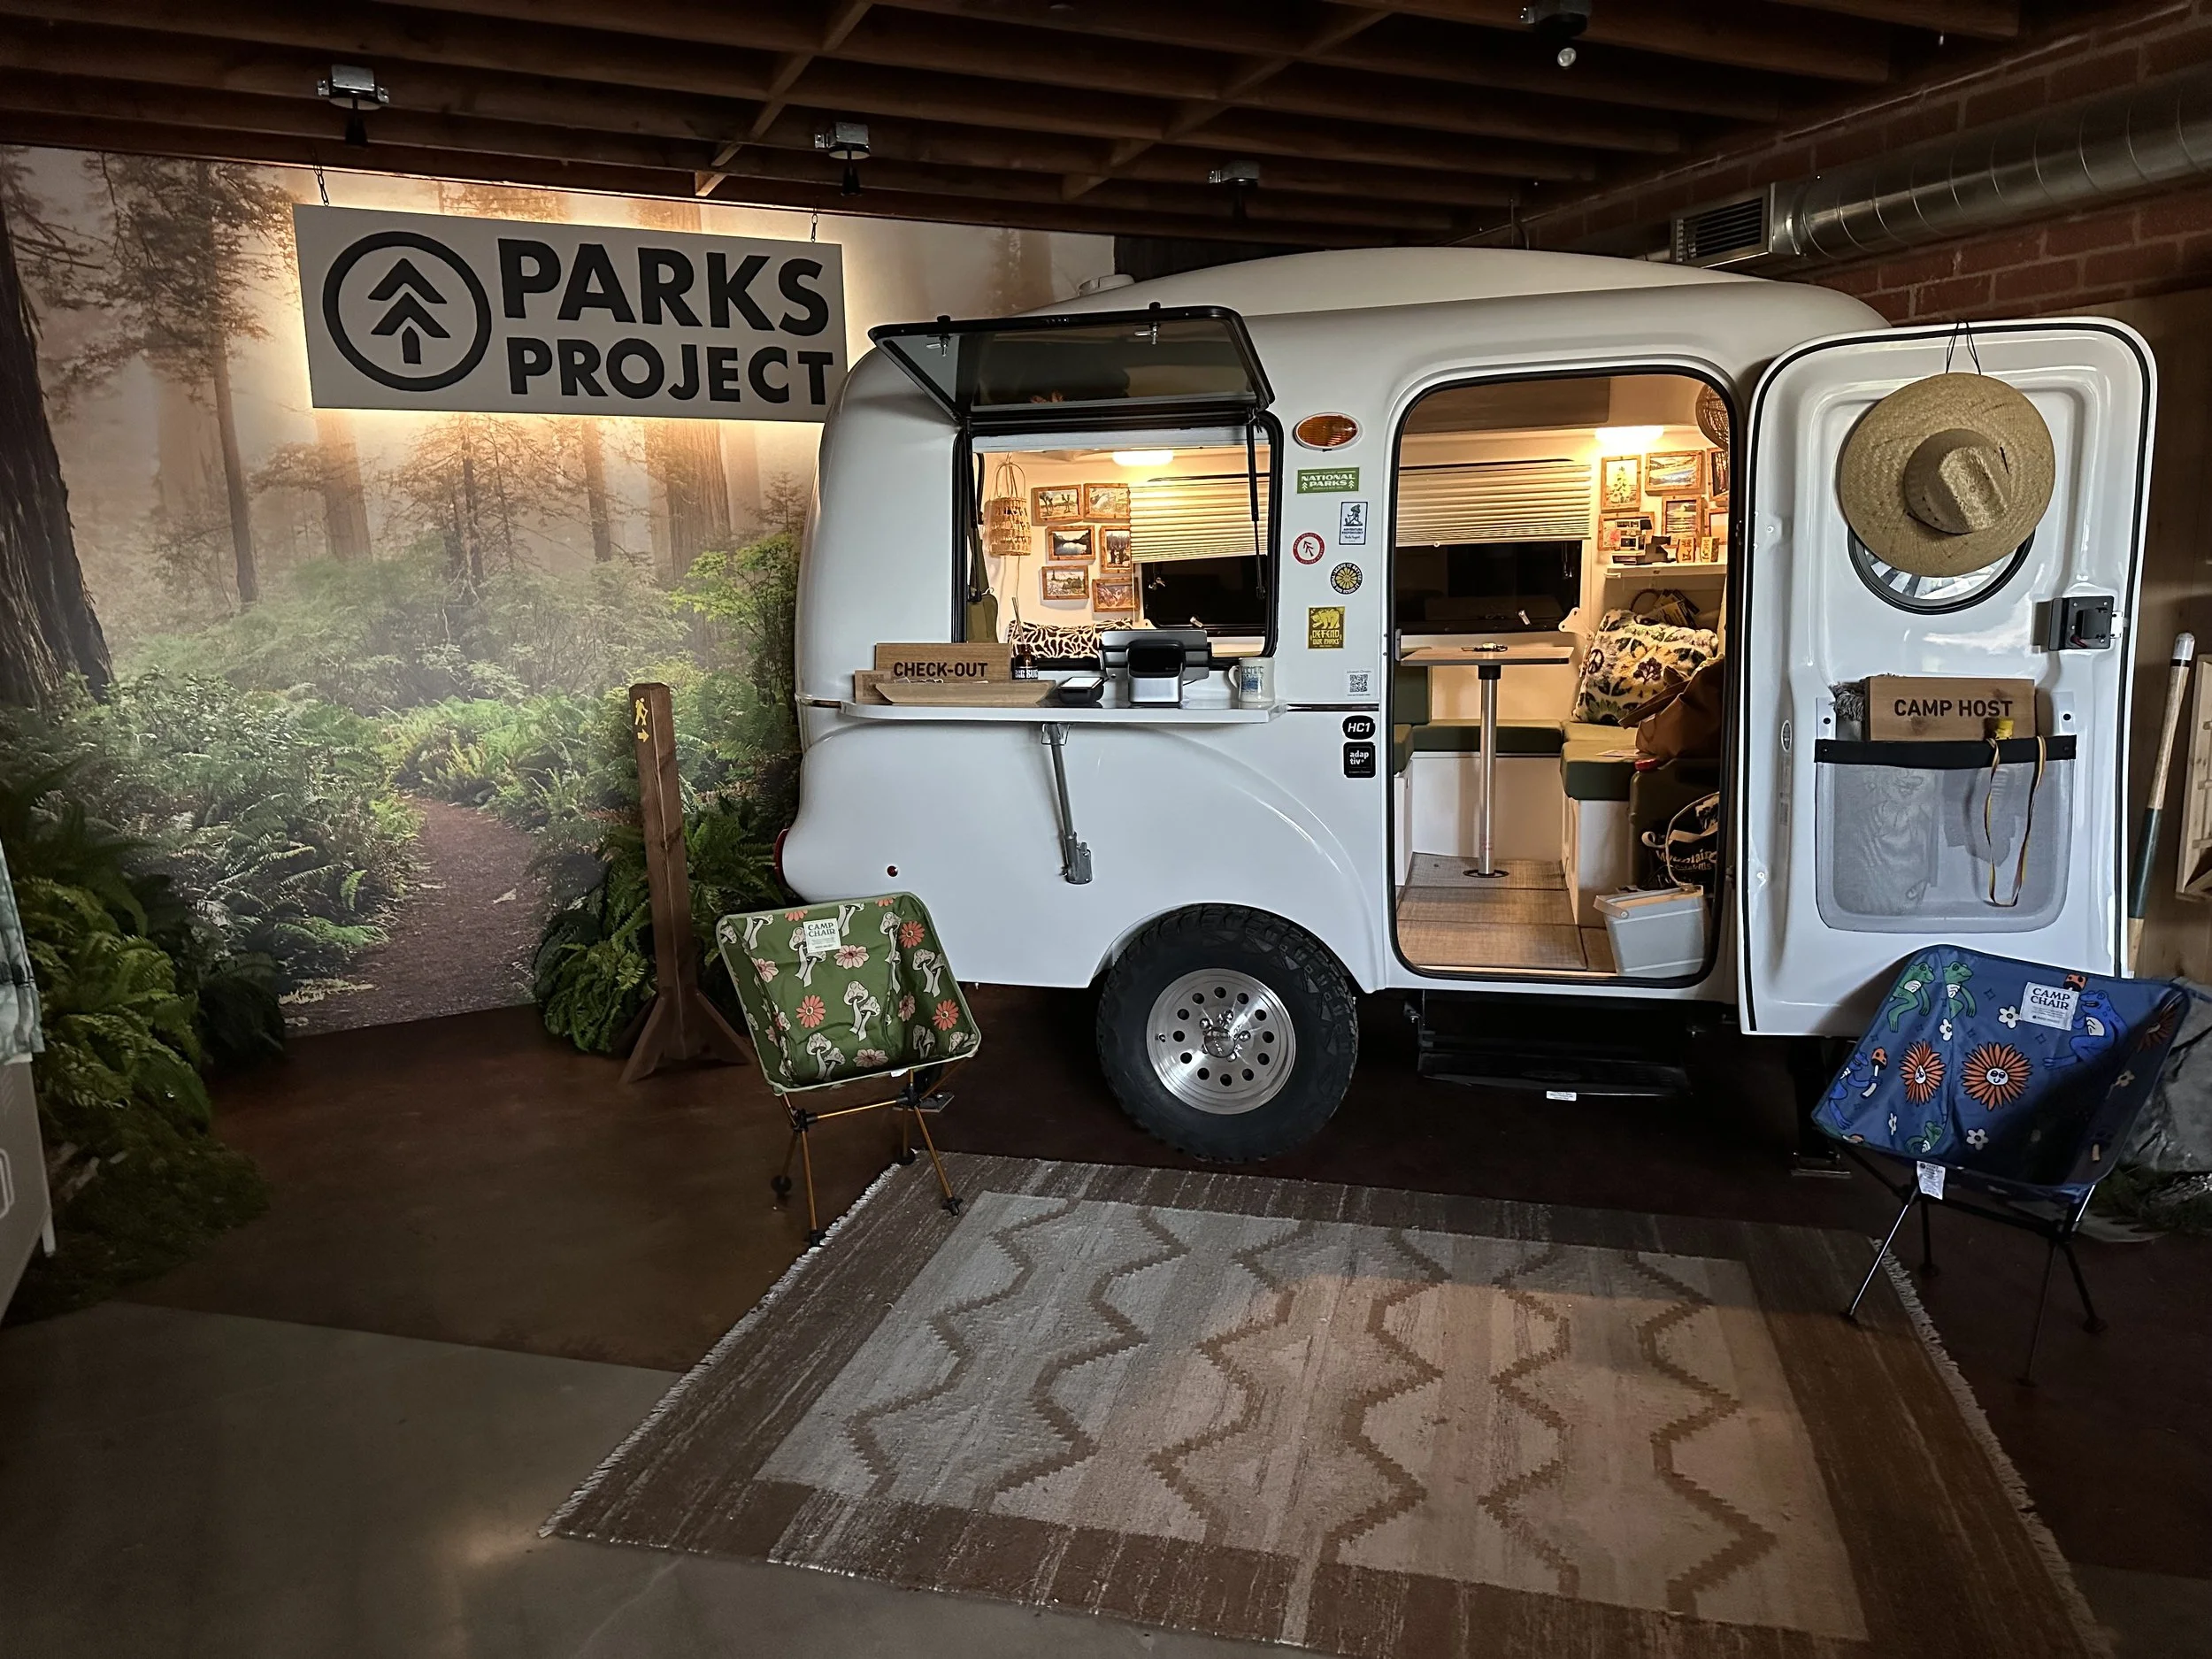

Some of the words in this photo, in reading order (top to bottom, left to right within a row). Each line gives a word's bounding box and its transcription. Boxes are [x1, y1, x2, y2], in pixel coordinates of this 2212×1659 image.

[497, 237, 830, 337] PARKS
[506, 336, 834, 406] PROJECT
[1301, 473, 1356, 482] NATIONAL
[1312, 629, 1340, 638] DEFEND
[894, 662, 988, 677] CHECK-OUT
[1894, 699, 1953, 717] CAMP
[1958, 699, 2014, 718] HOST
[1348, 722, 1371, 733] HC1
[1349, 749, 1370, 760] adap
[807, 922, 834, 931] CAMP
[808, 928, 836, 938] CHAIR
[2032, 987, 2071, 1001] CAMP
[2030, 995, 2070, 1010] CHAIR
